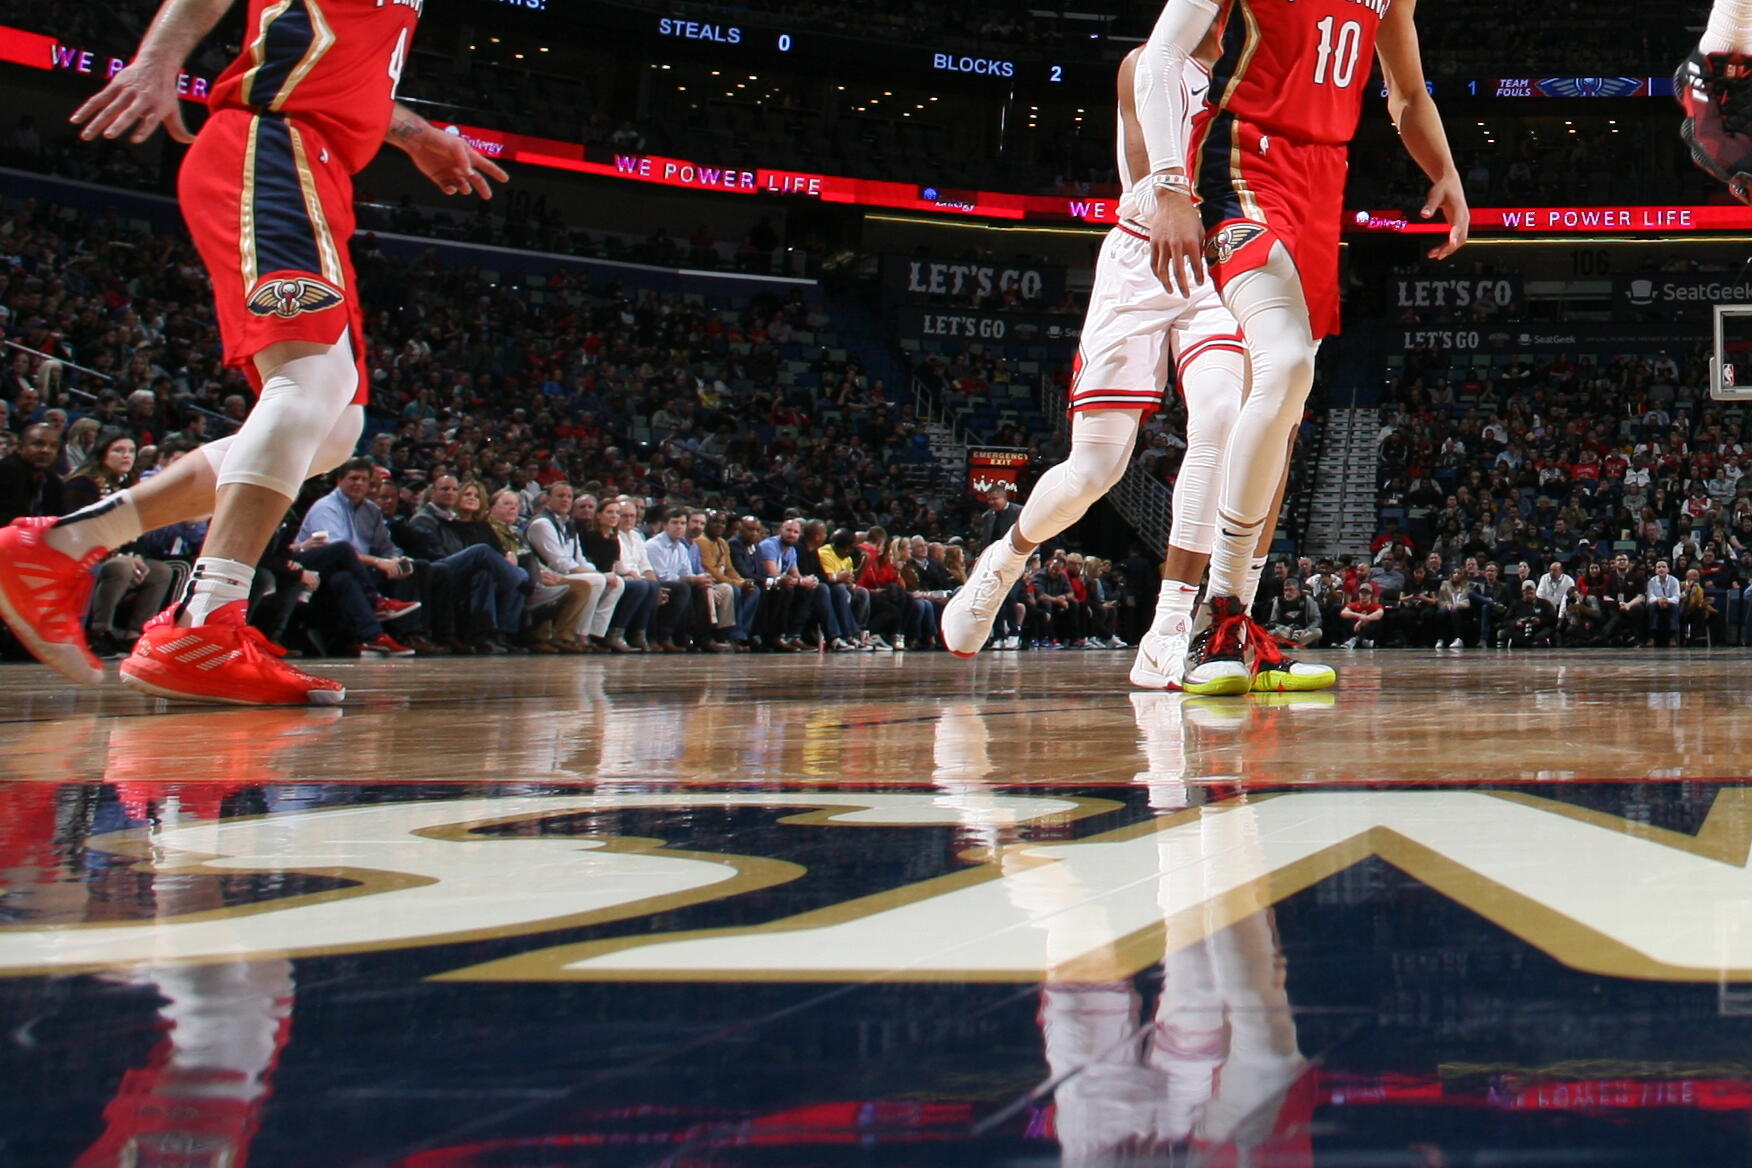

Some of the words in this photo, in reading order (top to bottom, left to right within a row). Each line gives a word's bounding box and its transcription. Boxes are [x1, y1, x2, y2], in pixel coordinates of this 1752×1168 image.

[659, 17, 742, 45] STEALS
[777, 34, 791, 52] 0
[387, 26, 408, 101] 4
[1312, 15, 1362, 89] 10
[51, 44, 95, 73] WE
[106, 58, 208, 98] PER
[933, 52, 1014, 77] BLOCKS
[1050, 65, 1062, 82] 2
[1467, 81, 1476, 95] 1
[1496, 87, 1532, 97] FOULS
[1500, 79, 1528, 88] TEAM
[614, 153, 651, 178] WE
[664, 163, 755, 190] POWER
[768, 173, 822, 196] LIFE
[1070, 201, 1104, 219] WE
[1502, 211, 1536, 227] WE
[1548, 211, 1632, 227] POWER
[1643, 210, 1692, 226] LIFE
[908, 261, 994, 298] LET'S
[1398, 280, 1471, 308] LET'S
[923, 314, 977, 337] LET'S
[979, 318, 1005, 339] GO
[1404, 332, 1452, 350] LET'S
[1456, 332, 1479, 349] GO
[990, 458, 1012, 466] EXIT
